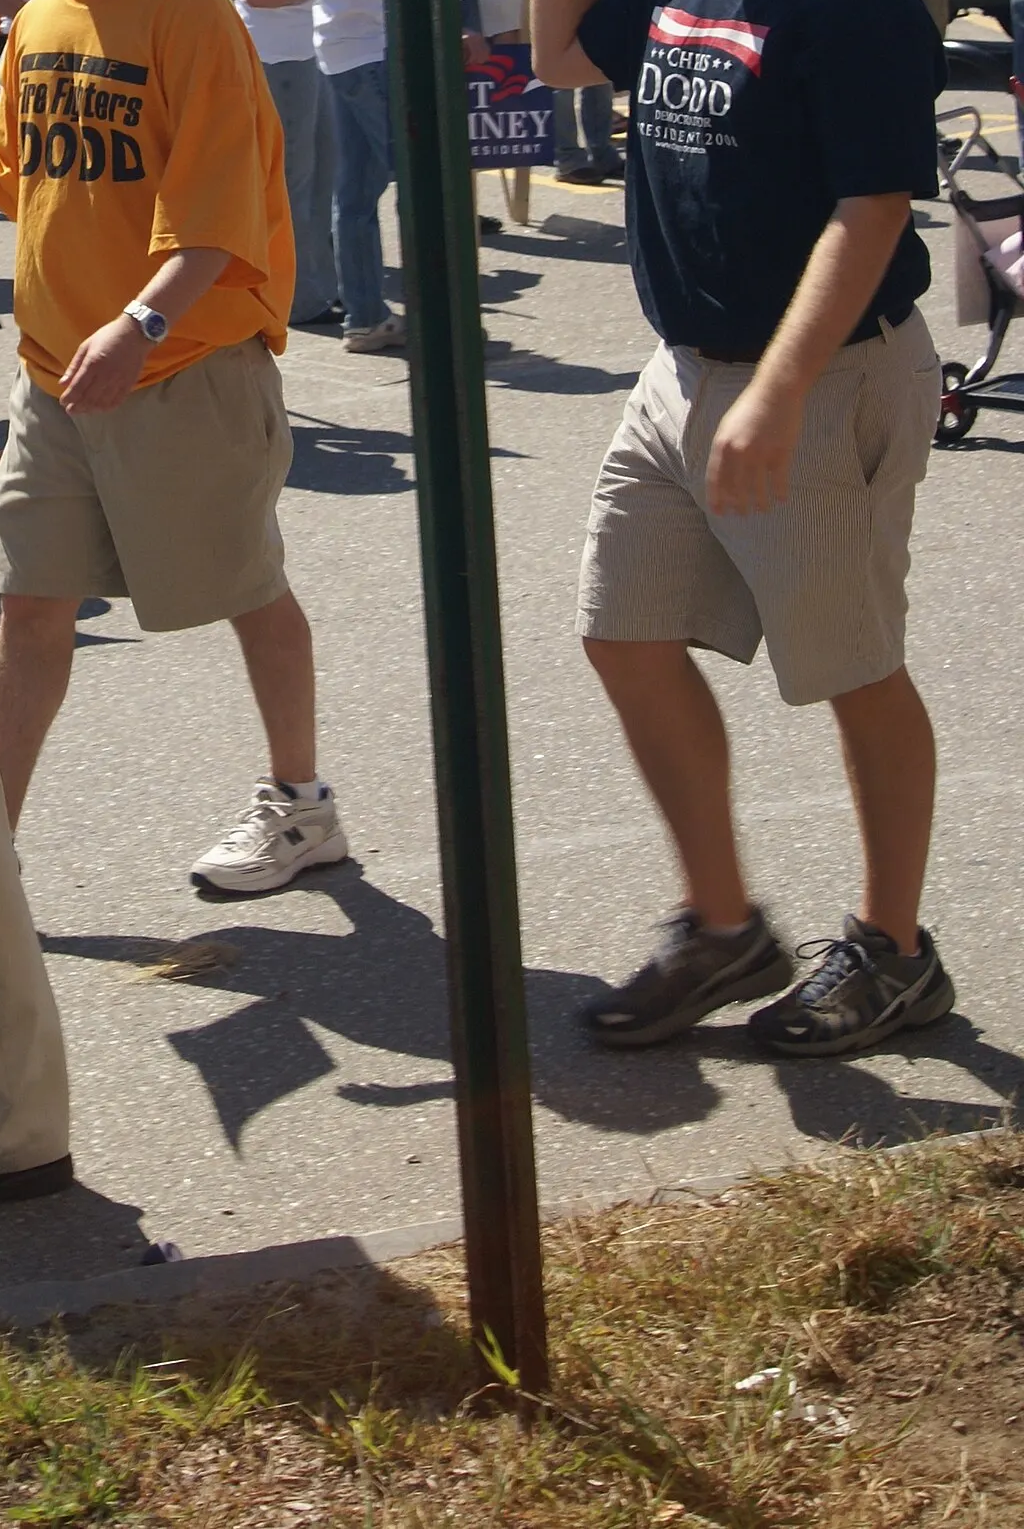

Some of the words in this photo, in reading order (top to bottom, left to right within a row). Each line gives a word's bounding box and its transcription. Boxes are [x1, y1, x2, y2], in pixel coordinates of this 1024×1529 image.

[21, 77, 48, 114] ire
[637, 62, 733, 117] DODD
[467, 110, 553, 141] NEY
[19, 121, 146, 183] DODD
[470, 143, 541, 157] ESIDENT
